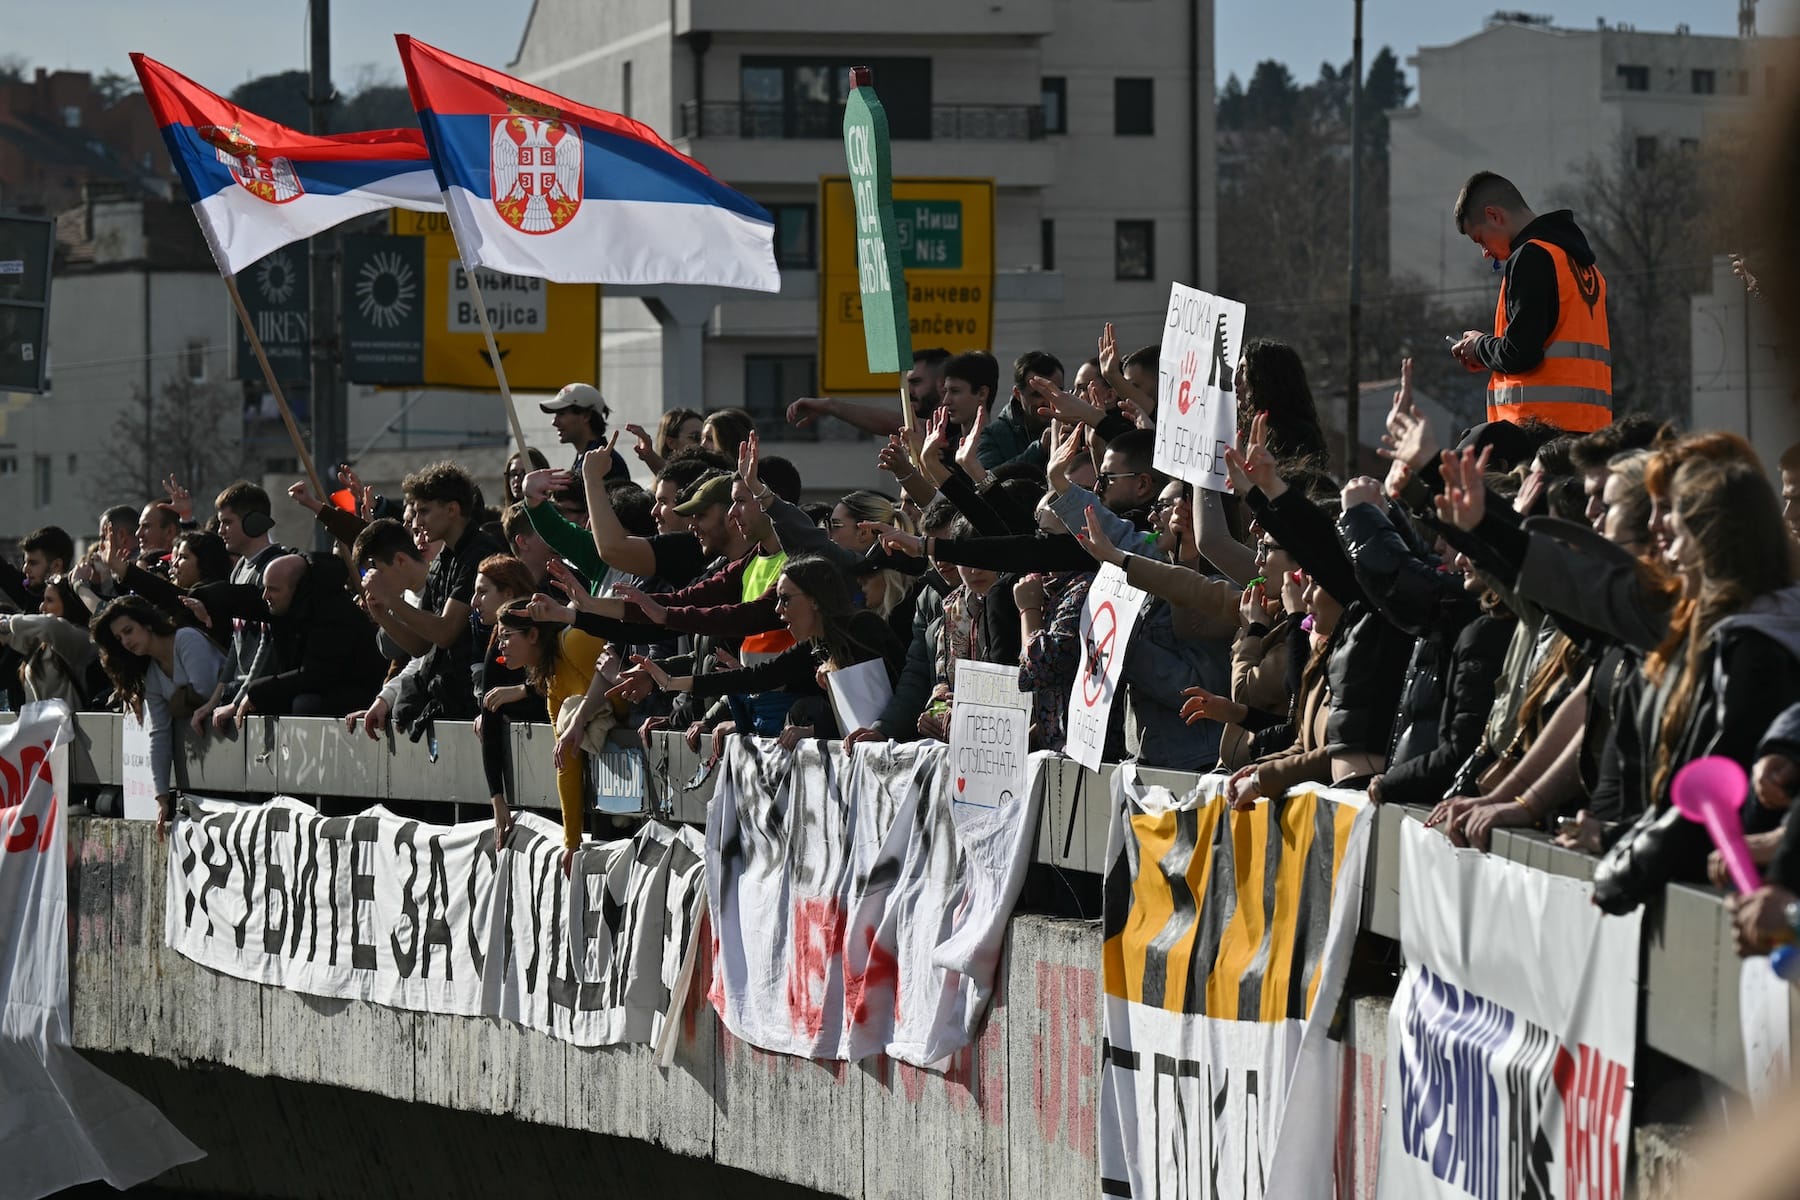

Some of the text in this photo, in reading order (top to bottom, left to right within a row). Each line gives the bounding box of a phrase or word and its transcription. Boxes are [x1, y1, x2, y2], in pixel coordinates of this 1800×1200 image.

[849, 125, 873, 176] СОК
[858, 180, 877, 233] ОД
[916, 208, 958, 230] Ниш
[916, 239, 947, 261] Niš
[906, 282, 982, 303] анчево
[909, 312, 977, 334] ančevo
[1169, 293, 1211, 341] ВИСОКА
[1173, 426, 1226, 476] БЕЖАЊЕ
[967, 715, 1012, 746] ПРЕВОЗ
[959, 747, 1018, 778] СТУДЕНАТА
[391, 820, 453, 983] ЗА
